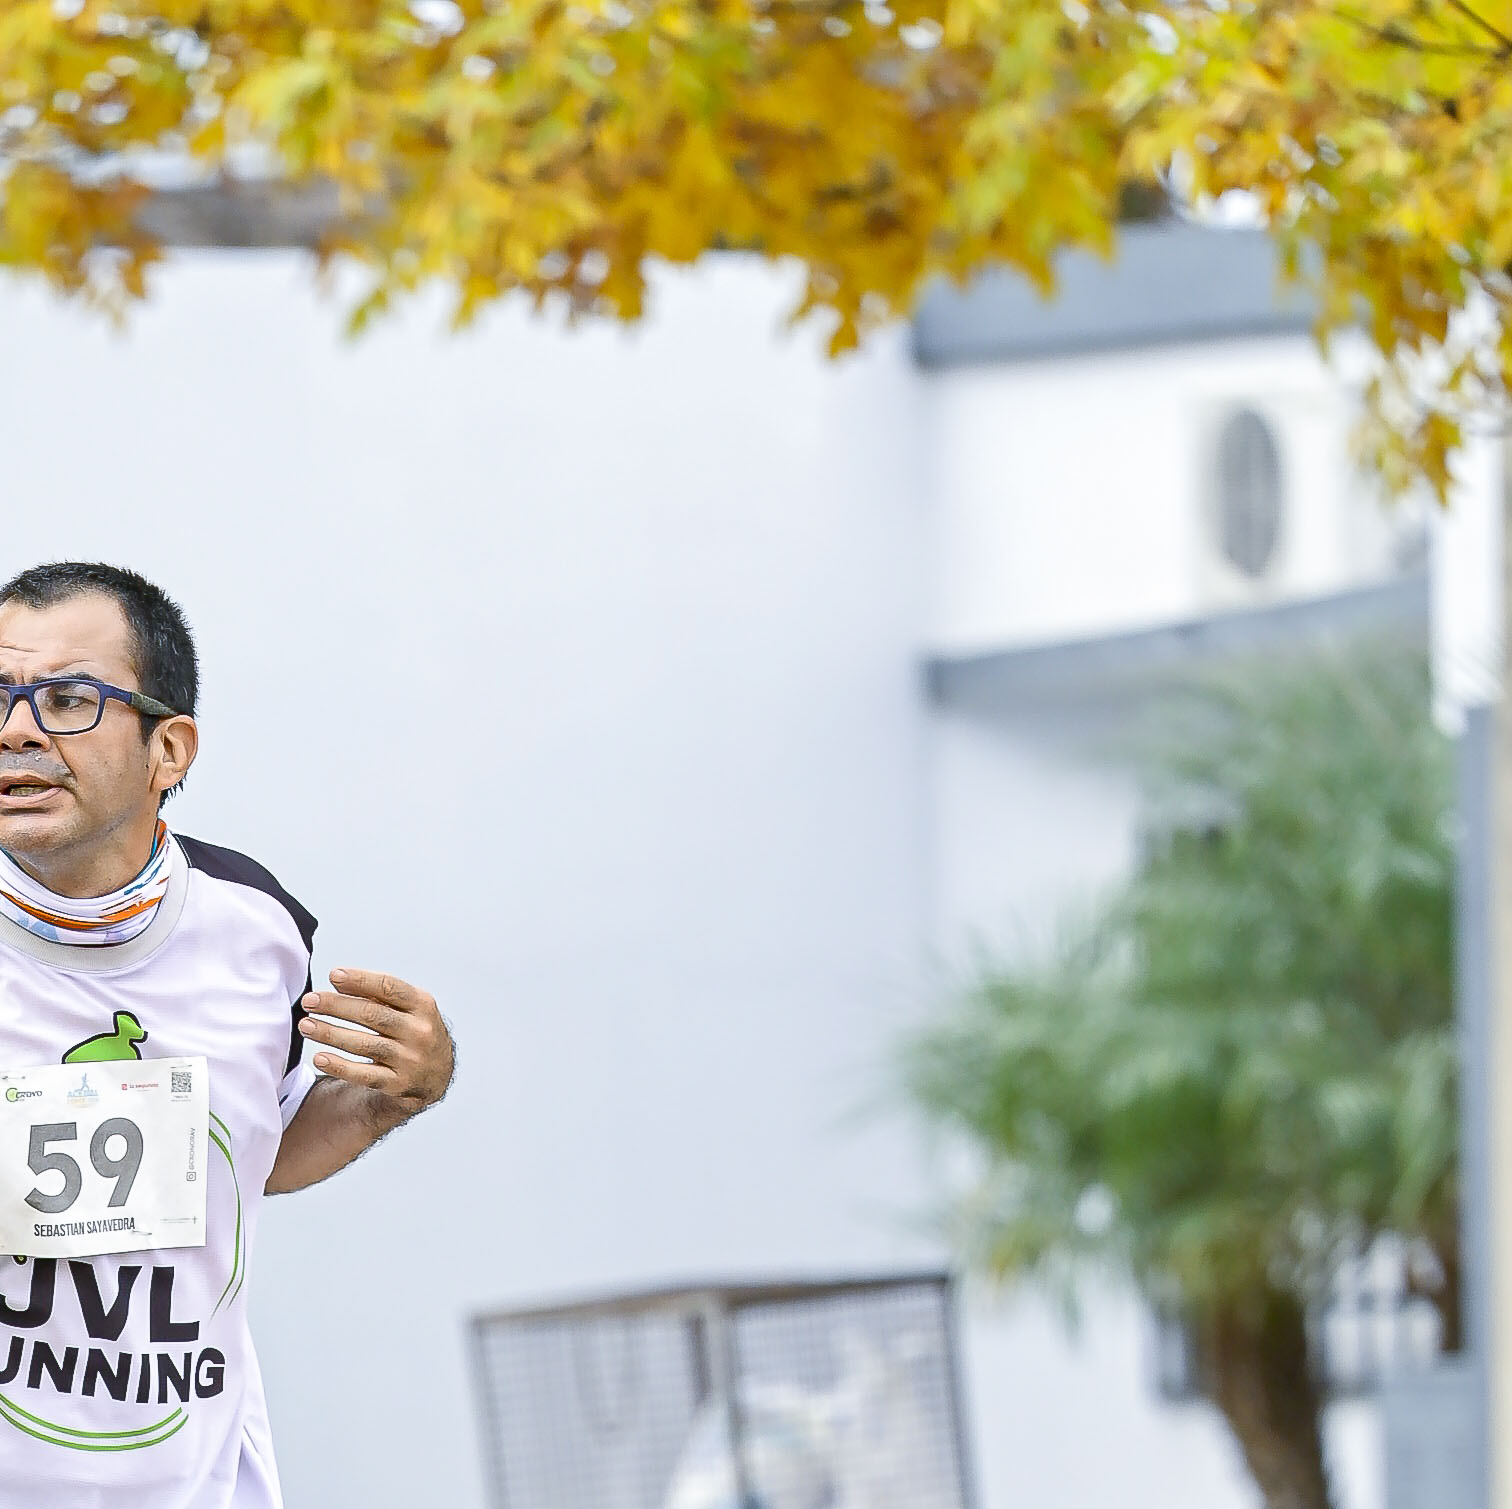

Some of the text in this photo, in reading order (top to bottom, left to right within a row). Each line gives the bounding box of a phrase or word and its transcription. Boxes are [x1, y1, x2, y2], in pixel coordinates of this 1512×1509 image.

[24, 1117, 144, 1213] 59
[33, 1217, 136, 1237] SEBASTIAN SAYAVEDRA
